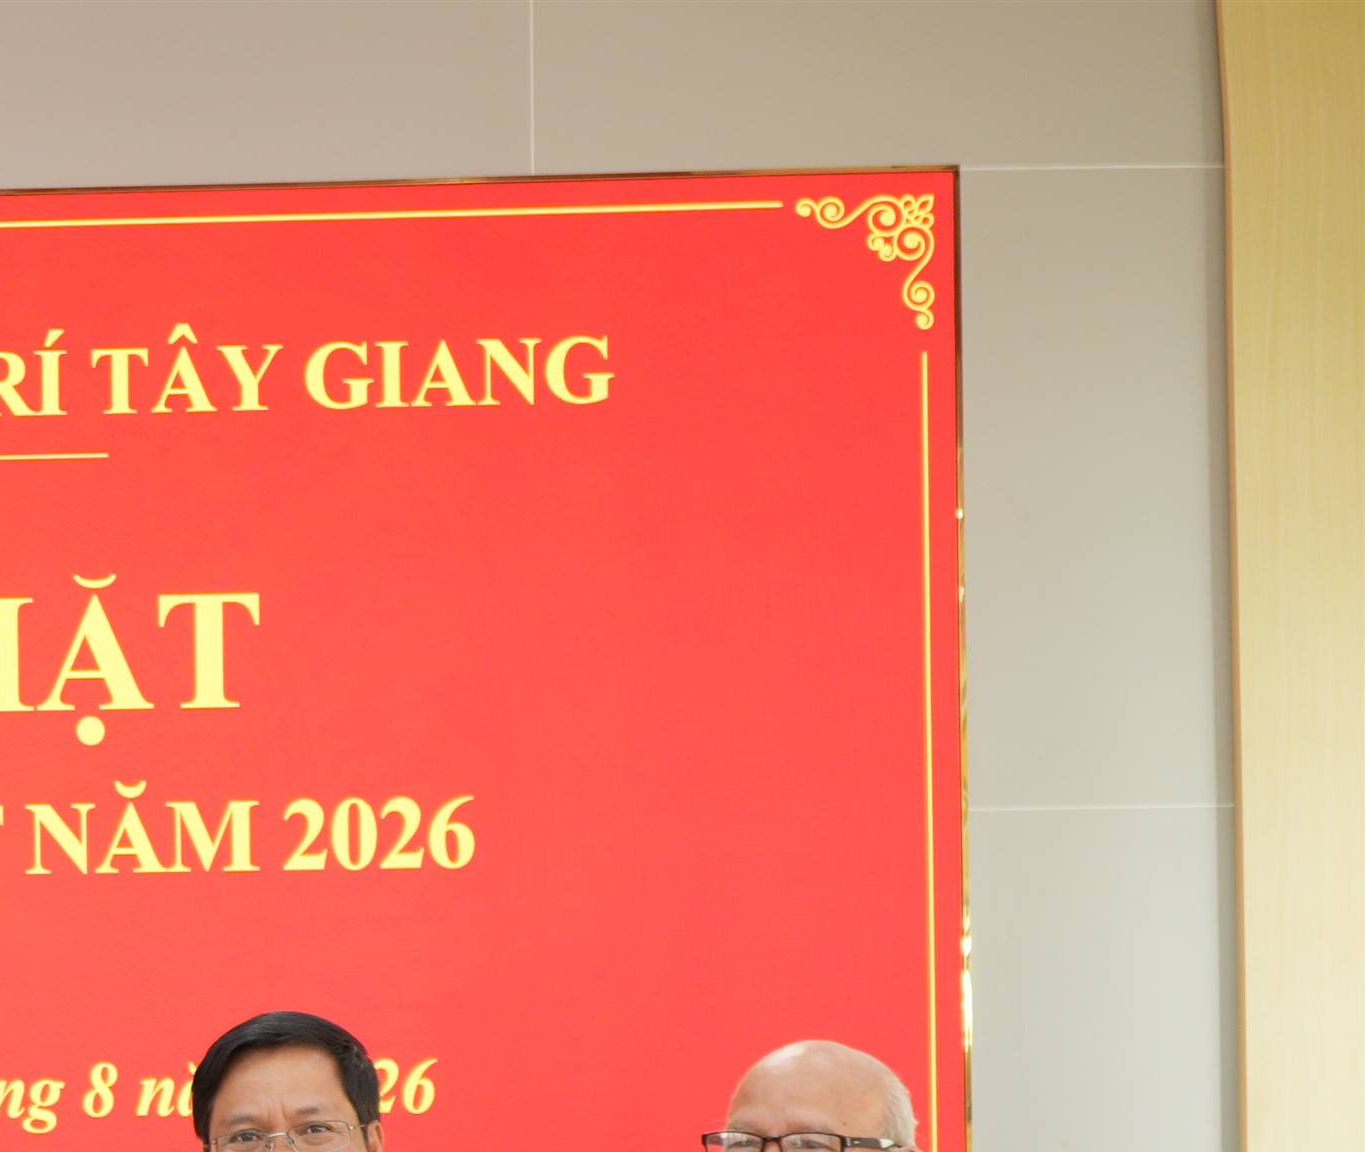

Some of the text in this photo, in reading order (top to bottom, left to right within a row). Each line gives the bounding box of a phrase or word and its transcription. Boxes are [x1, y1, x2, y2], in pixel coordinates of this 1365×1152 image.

[91, 323, 283, 415] TÂY
[304, 335, 615, 410] GIANG
[24, 780, 260, 875] NĂM
[282, 795, 476, 871] 2026
[82, 1062, 118, 1118] 8
[377, 1058, 438, 1115] 26
